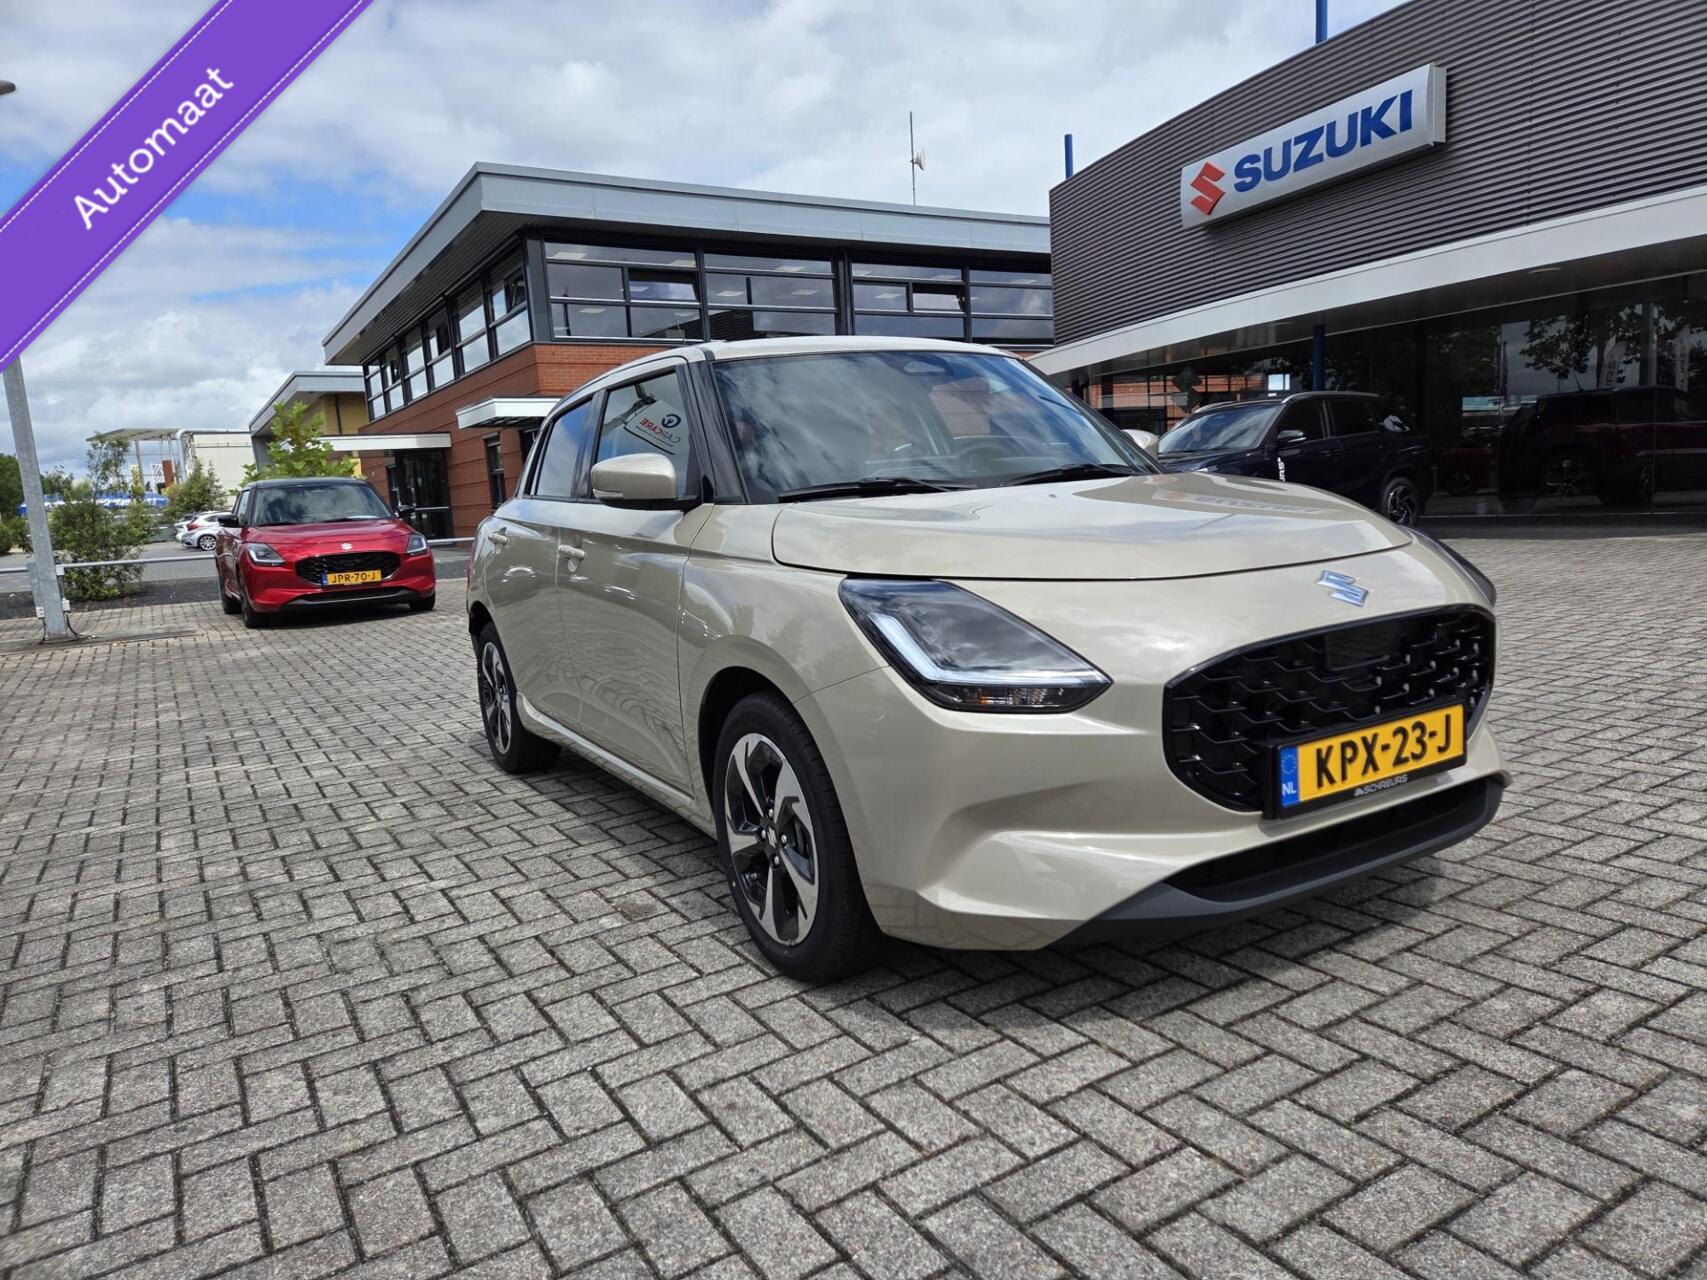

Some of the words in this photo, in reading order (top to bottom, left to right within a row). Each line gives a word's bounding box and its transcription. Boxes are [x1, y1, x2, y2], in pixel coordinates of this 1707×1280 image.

[1234, 89, 1413, 193] SUZUKI
[1281, 782, 1297, 795] NL
[1315, 714, 1452, 789] KPX-23-J
